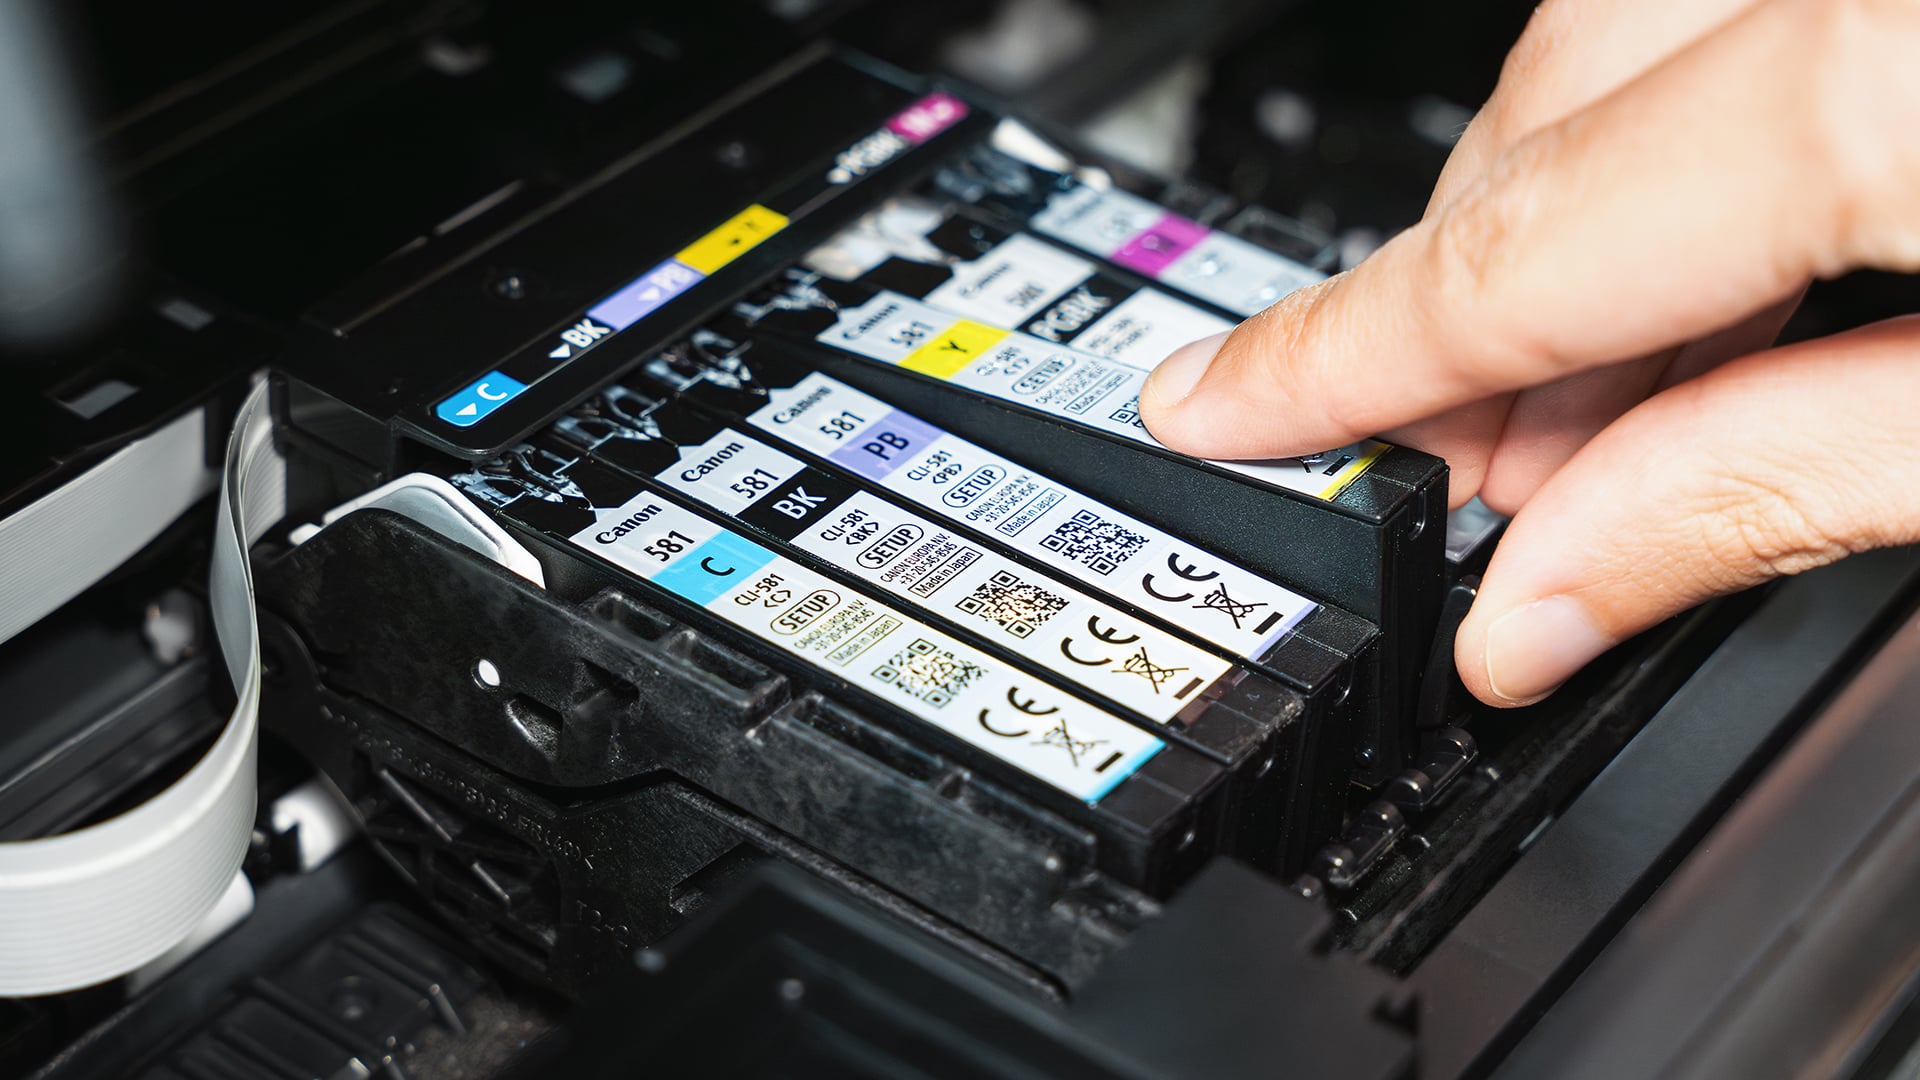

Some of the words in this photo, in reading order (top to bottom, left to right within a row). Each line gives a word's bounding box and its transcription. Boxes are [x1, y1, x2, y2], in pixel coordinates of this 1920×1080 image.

[560, 318, 611, 348] BK
[938, 340, 969, 354] Y
[476, 382, 508, 402] C
[773, 386, 832, 424] Canon
[819, 411, 865, 440] 581
[680, 442, 744, 482] Canon
[862, 431, 910, 461] PB
[907, 450, 953, 481] CLI-581
[932, 463, 963, 485] <PB>
[730, 468, 780, 499] 581
[950, 469, 997, 504] SETUP
[771, 486, 827, 519] BK
[965, 500, 993, 521] CANON
[1002, 514, 1029, 533] Made
[1031, 492, 1059, 513] Japan
[595, 503, 664, 545] Canon
[820, 508, 869, 541] CLI-581
[845, 522, 879, 546] <BK>
[643, 530, 696, 562] 581
[865, 528, 915, 565] SETUP
[880, 561, 908, 583] CANON
[905, 539, 938, 565] EUROPA
[700, 557, 736, 576] C
[899, 542, 958, 585] +31-20-545-8545
[915, 574, 945, 594] Made
[937, 567, 953, 578] in
[947, 551, 976, 573] Japan
[1142, 552, 1220, 602] CE
[734, 573, 785, 607] CLI-581
[763, 589, 792, 608] <C>
[779, 594, 830, 630] SETUP
[832, 640, 861, 661] Made
[867, 619, 895, 638] Japan
[1060, 615, 1140, 666] CE
[978, 686, 1059, 737] CE
